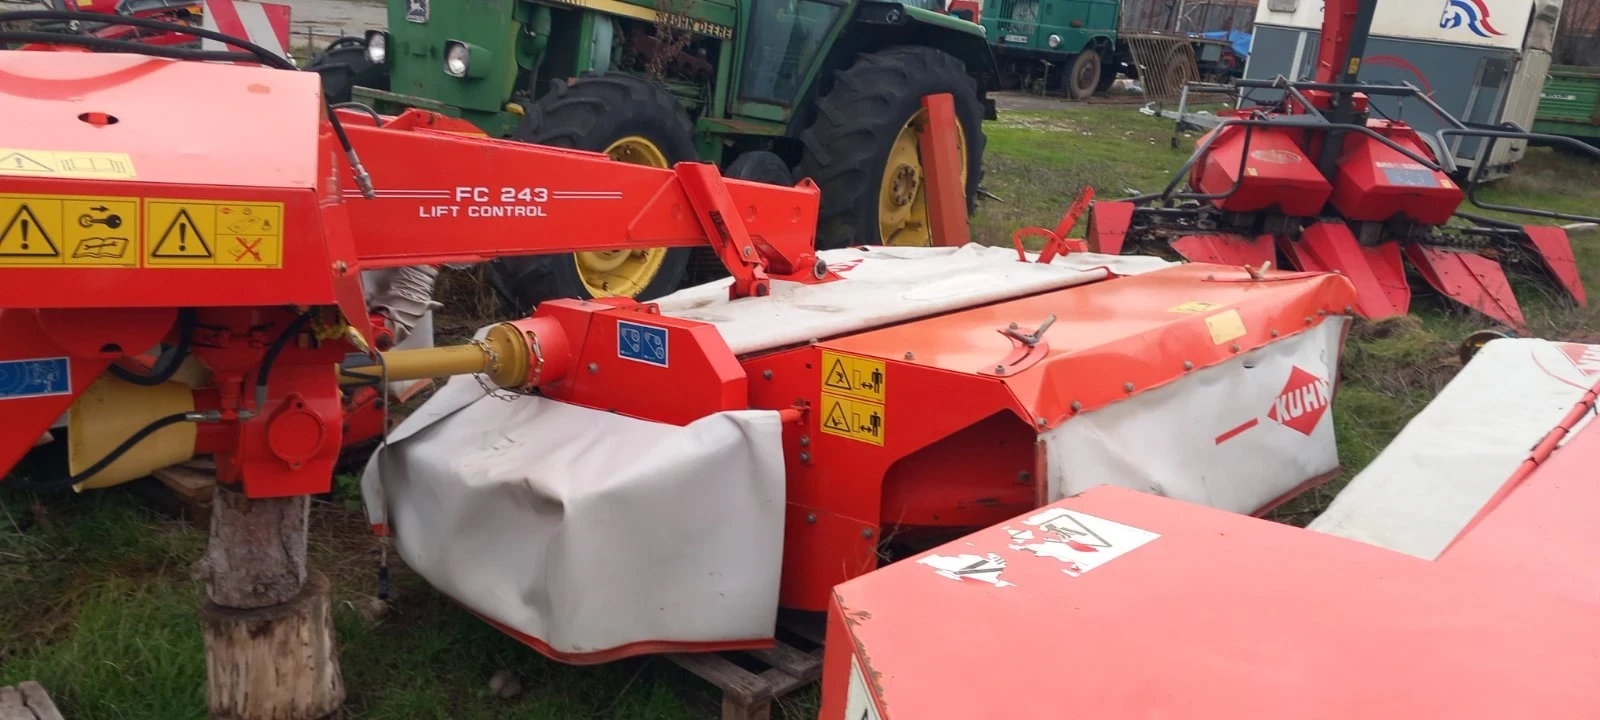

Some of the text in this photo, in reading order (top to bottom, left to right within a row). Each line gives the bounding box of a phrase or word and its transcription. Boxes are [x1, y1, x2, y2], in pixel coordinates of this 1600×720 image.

[699, 20, 732, 39] DEERE
[455, 186, 548, 202] FC 243
[419, 205, 548, 218] LIFT CONTROL
[1275, 377, 1329, 425] KUHN
